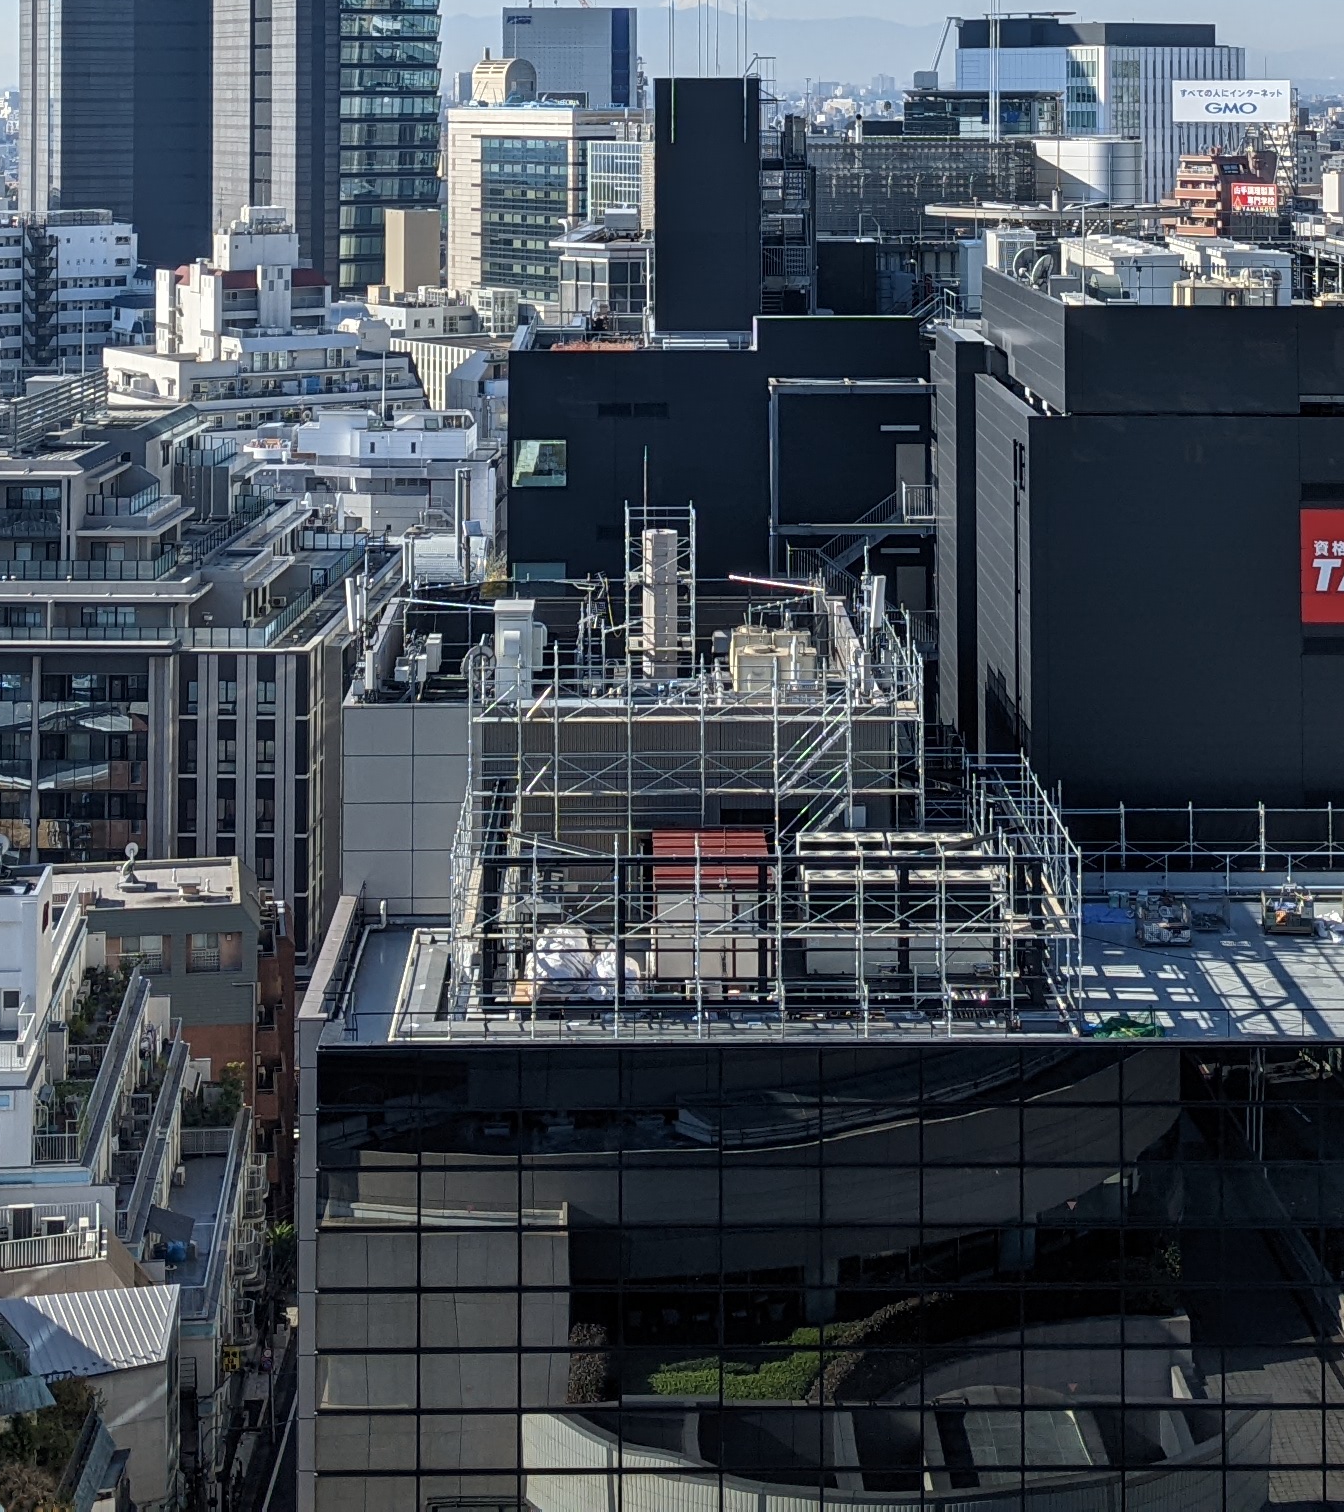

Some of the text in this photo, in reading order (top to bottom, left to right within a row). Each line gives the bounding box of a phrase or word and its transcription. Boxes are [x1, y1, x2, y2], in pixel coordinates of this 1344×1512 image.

[1179, 88, 1283, 98] すべての人にインターネット
[1205, 102, 1258, 114] GMO
